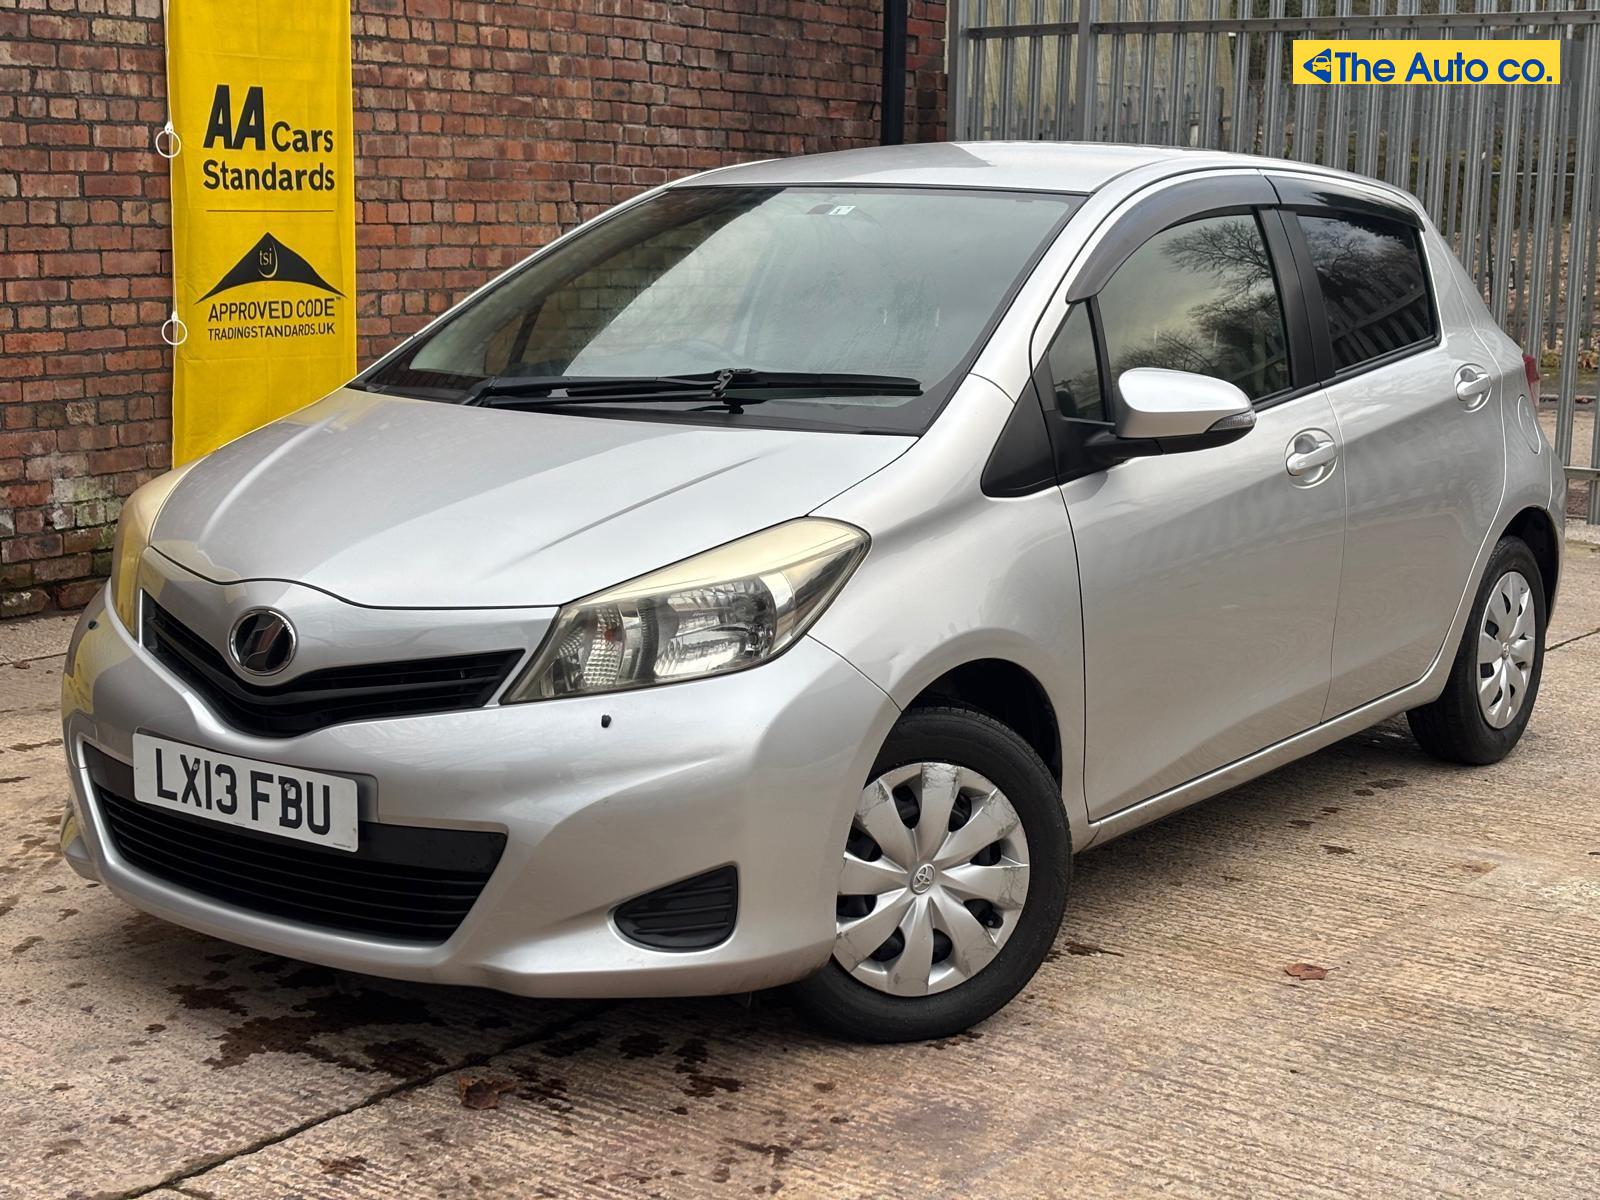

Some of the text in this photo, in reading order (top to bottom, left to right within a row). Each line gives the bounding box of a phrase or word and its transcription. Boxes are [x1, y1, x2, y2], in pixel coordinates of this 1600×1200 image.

[203, 84, 334, 152] AA Cars
[203, 159, 335, 191] Standards
[259, 247, 272, 266] tsi
[208, 297, 335, 322] APPROVED CODE
[208, 322, 336, 341] TRADINGSTANDARDS.UK
[155, 748, 330, 835] LX13 FBU
